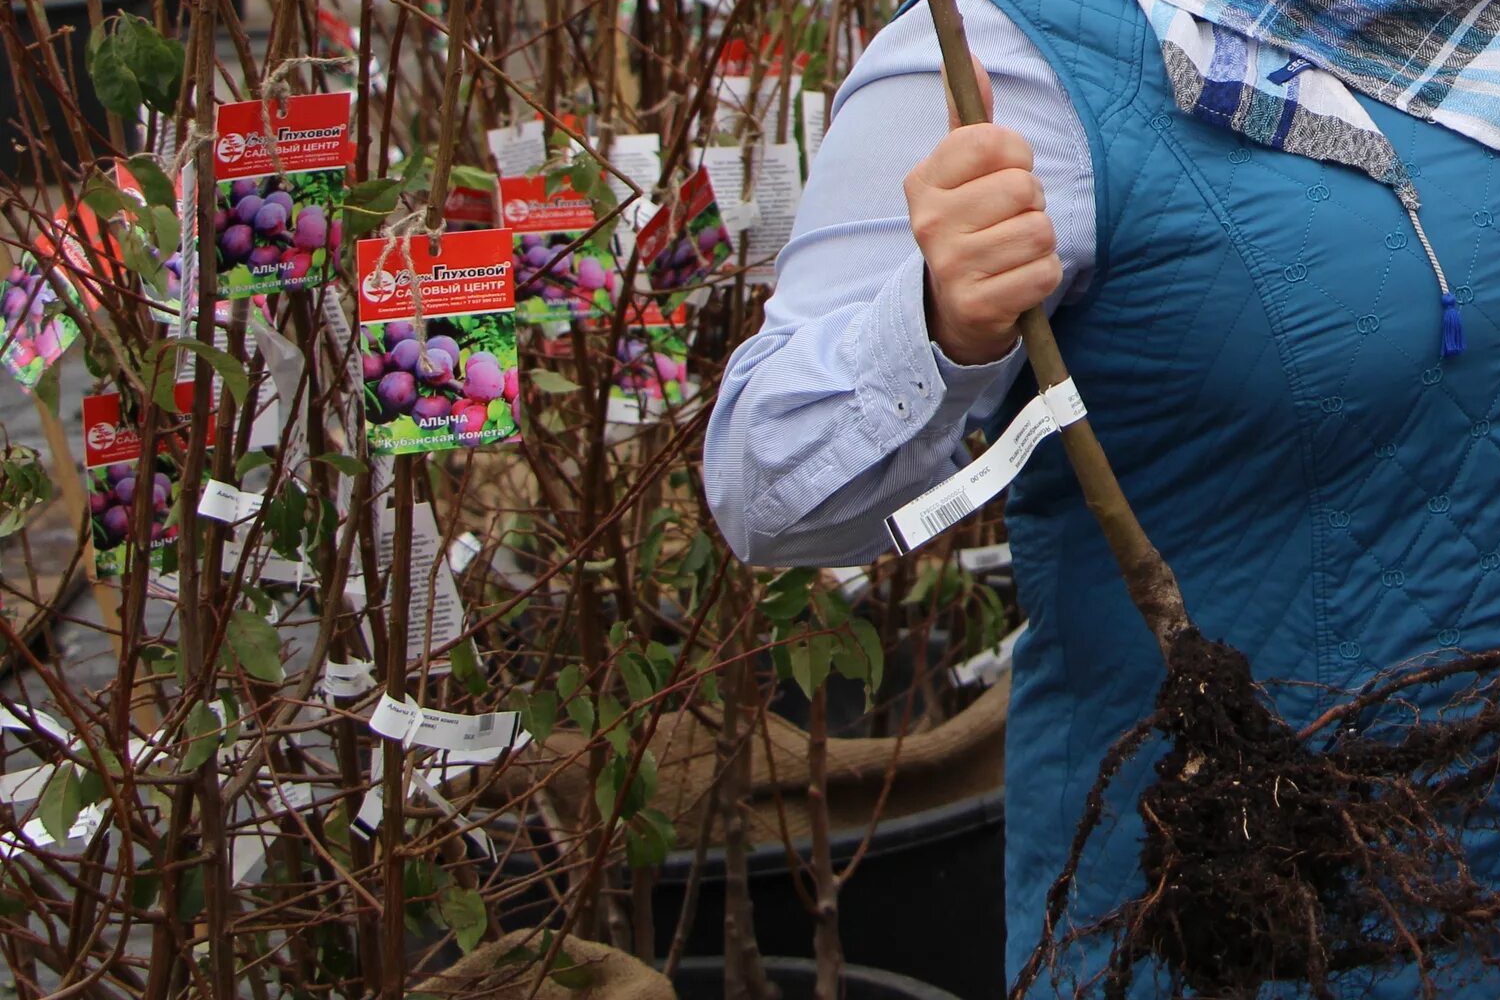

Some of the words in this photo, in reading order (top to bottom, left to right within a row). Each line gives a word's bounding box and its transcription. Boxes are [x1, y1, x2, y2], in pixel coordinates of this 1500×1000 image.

[303, 142, 339, 151] ЦЕНТР
[253, 262, 295, 274] АЛЫЧА
[464, 281, 505, 292] ЦЕНТР
[419, 414, 468, 428] АЛЫЧА
